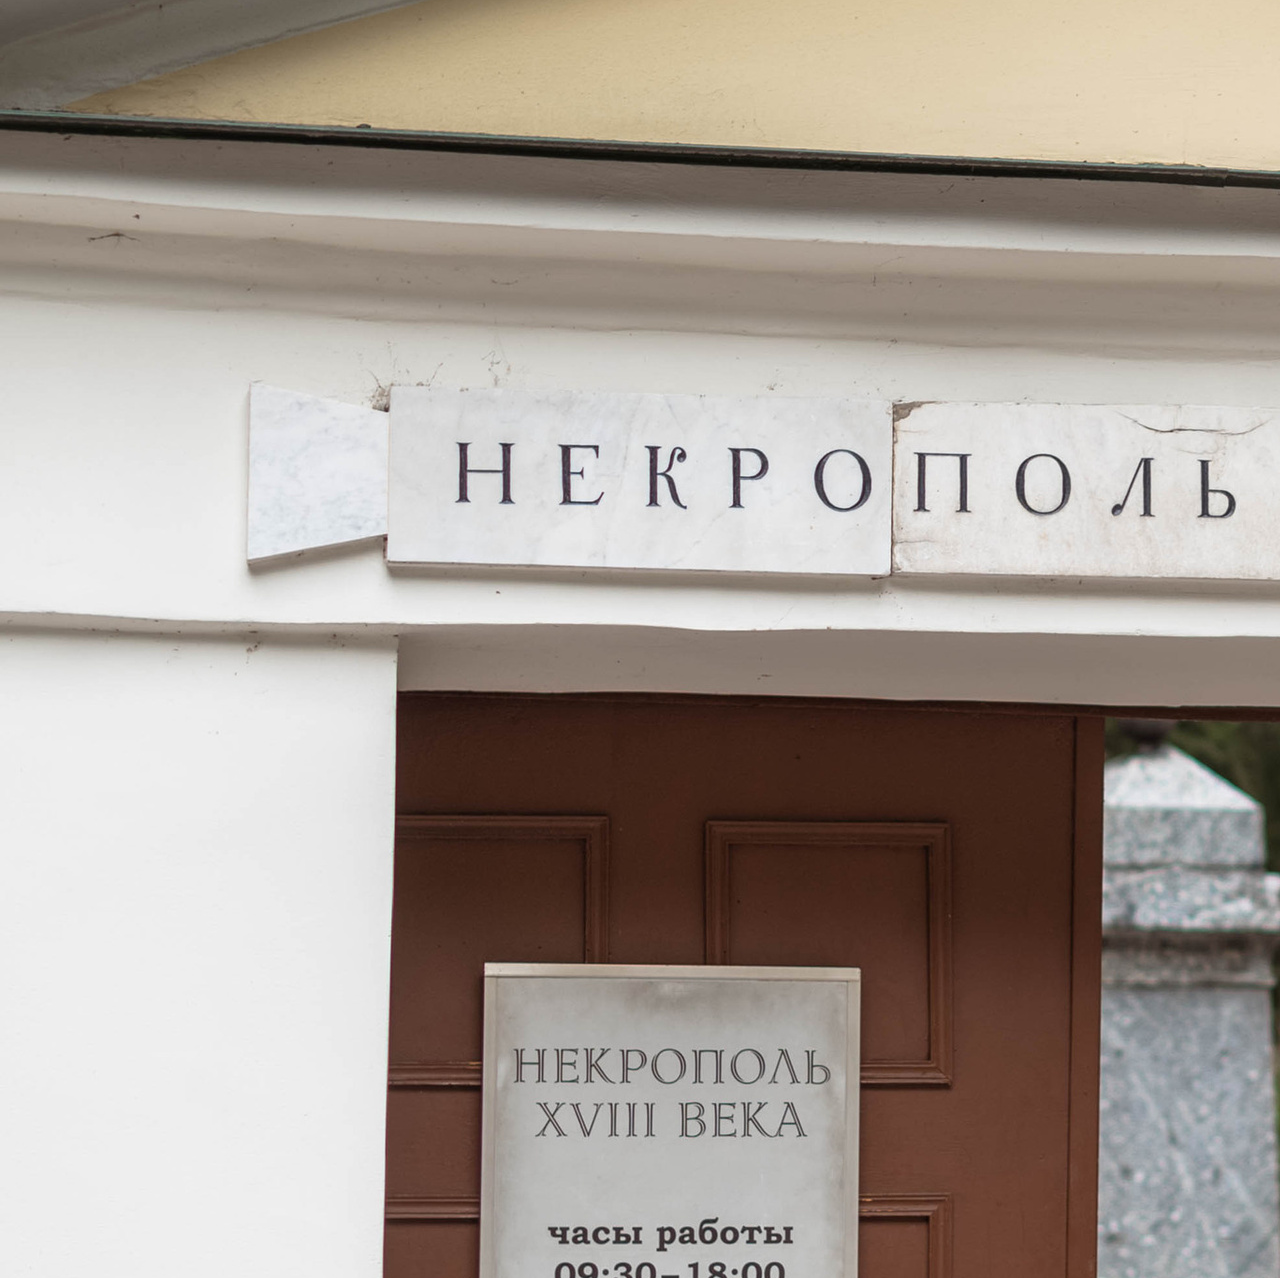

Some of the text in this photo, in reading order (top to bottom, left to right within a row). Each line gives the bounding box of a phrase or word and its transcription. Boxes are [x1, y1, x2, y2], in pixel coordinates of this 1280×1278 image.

[455, 441, 1238, 521] НЕКРОПОЛЬ
[512, 1047, 832, 1085] НЕКРОПОЛЬ
[534, 1101, 808, 1138] XVIII ВЕКА
[547, 1217, 794, 1252] часы работы
